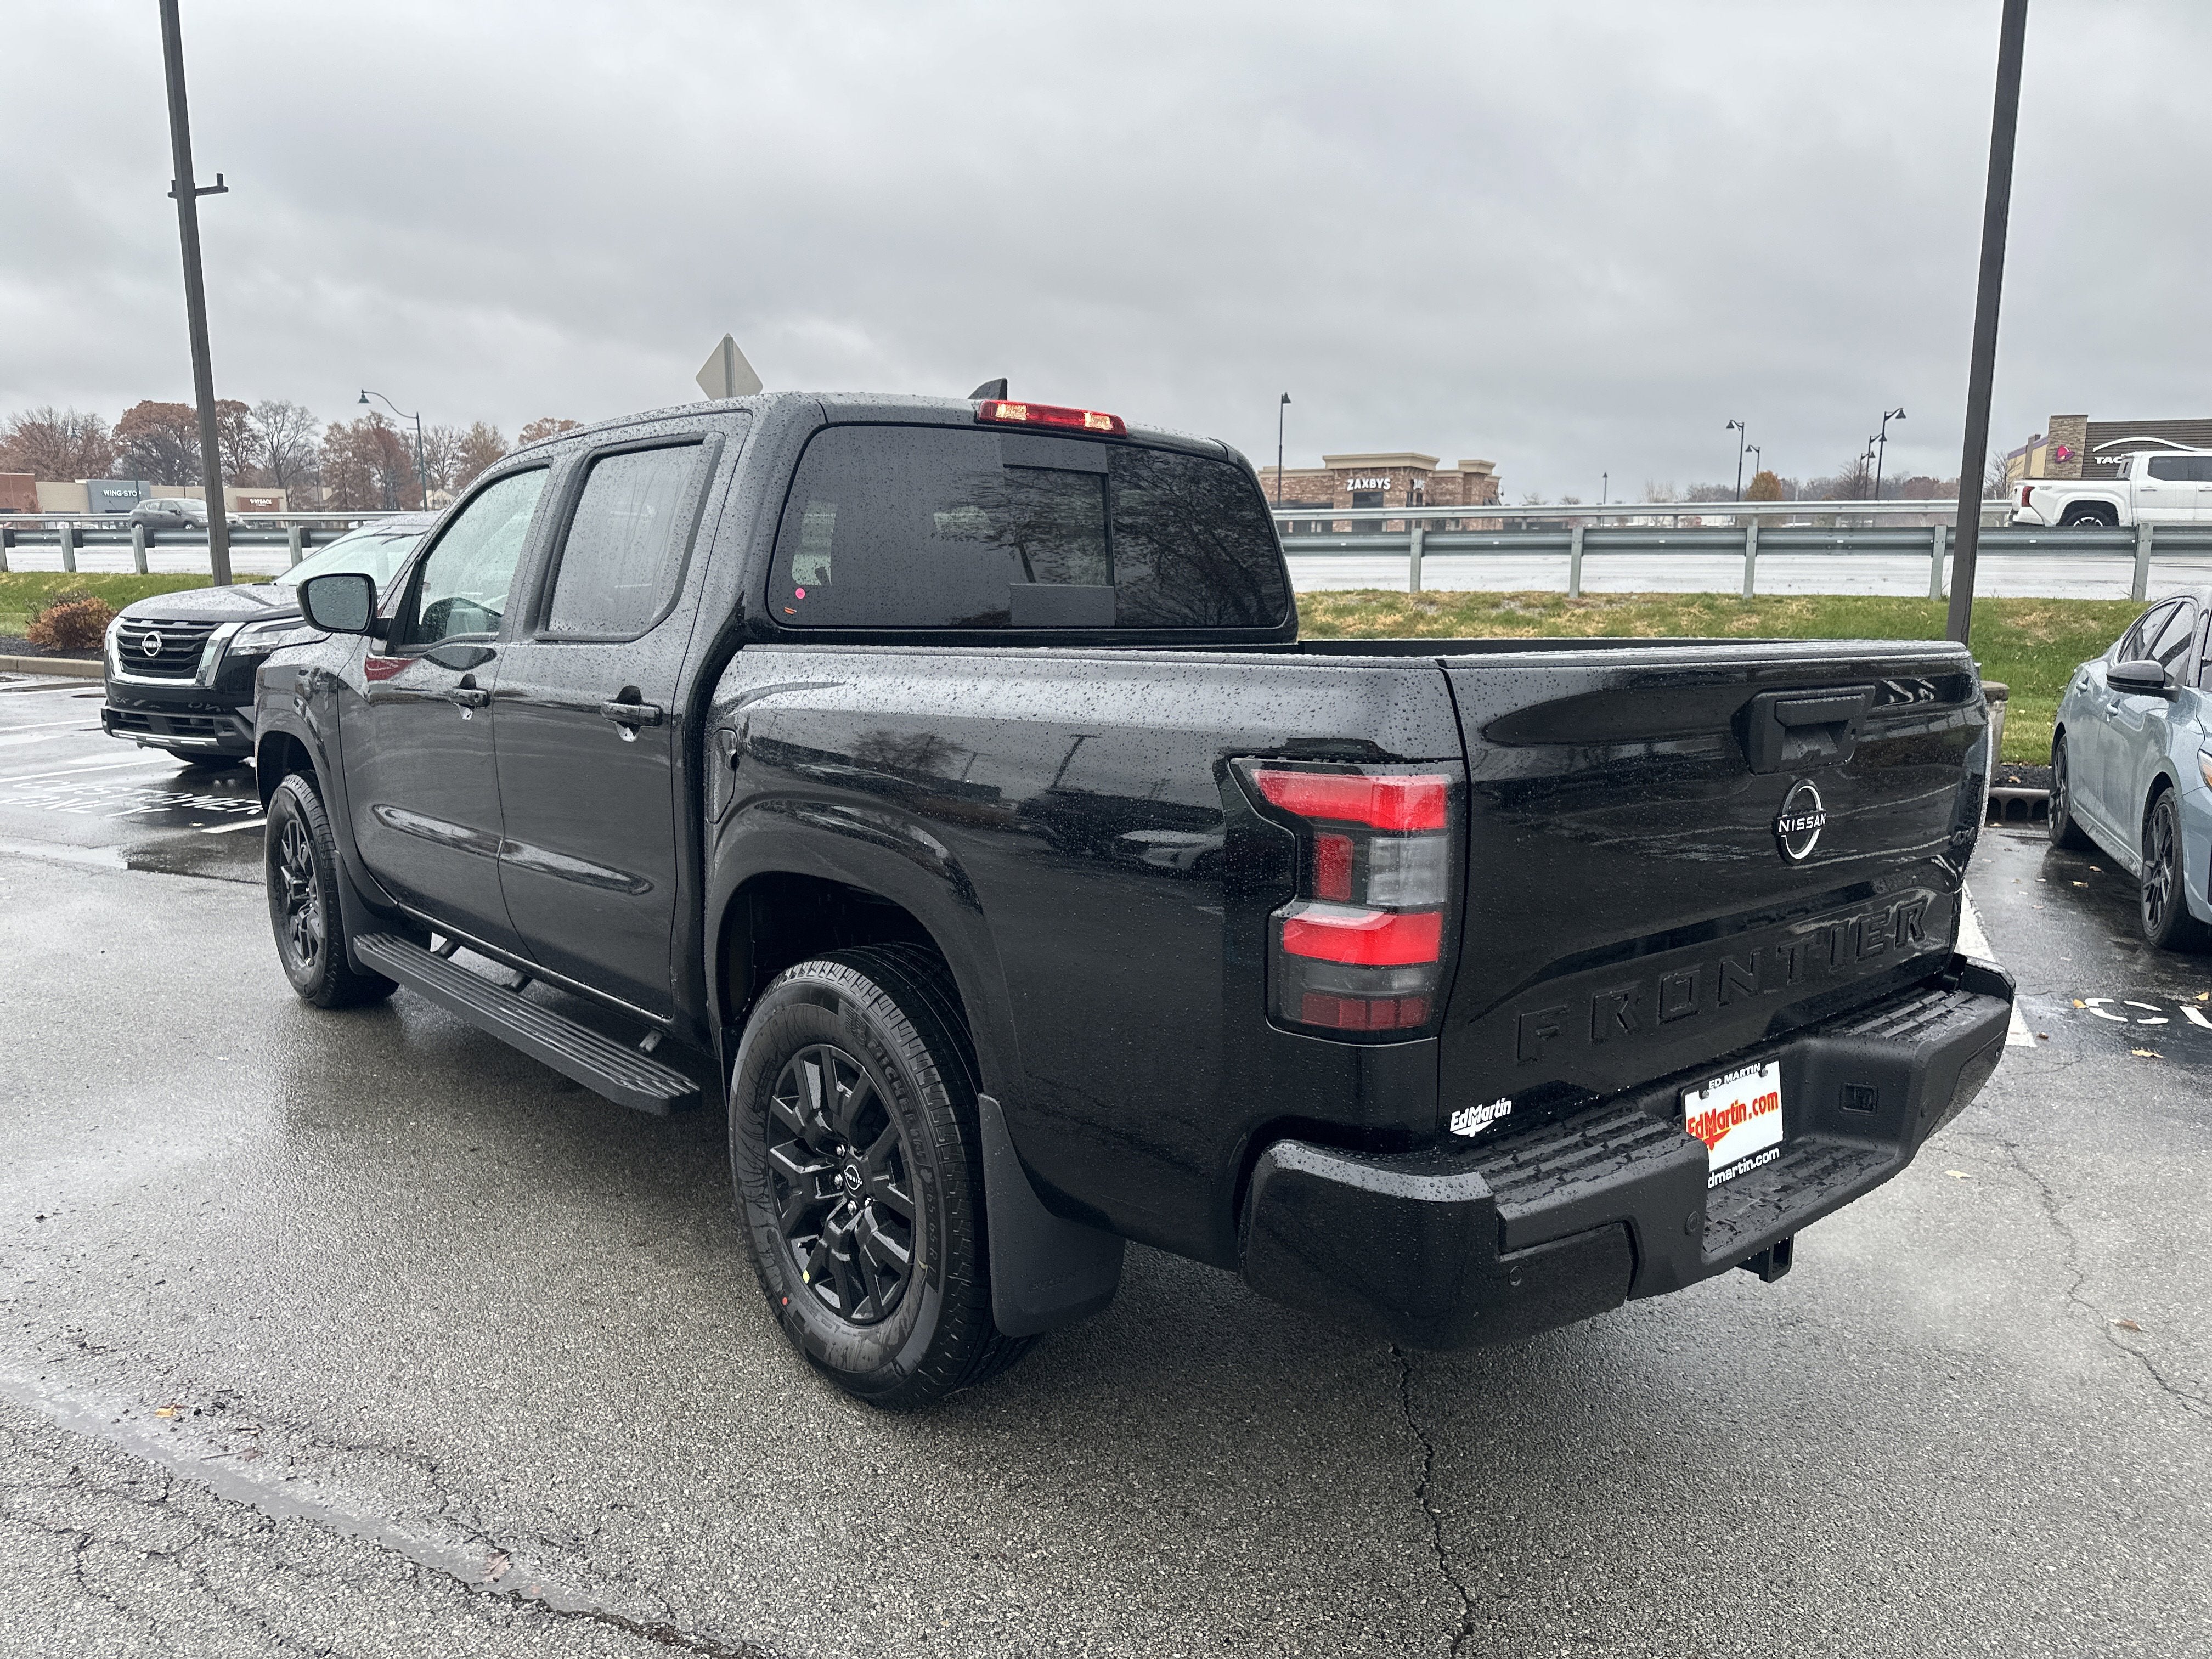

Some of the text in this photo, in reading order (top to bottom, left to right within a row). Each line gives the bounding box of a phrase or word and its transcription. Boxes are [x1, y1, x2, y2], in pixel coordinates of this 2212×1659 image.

[1347, 478, 1391, 492] ZAXBYS
[1778, 813, 1827, 833] NISSAN
[1516, 899, 1929, 1063] FRONTIER
[1708, 1062, 1761, 1090] ED MARTIN
[1449, 1097, 1513, 1133] EdMartin
[1687, 1091, 1779, 1139] EdMartin.com
